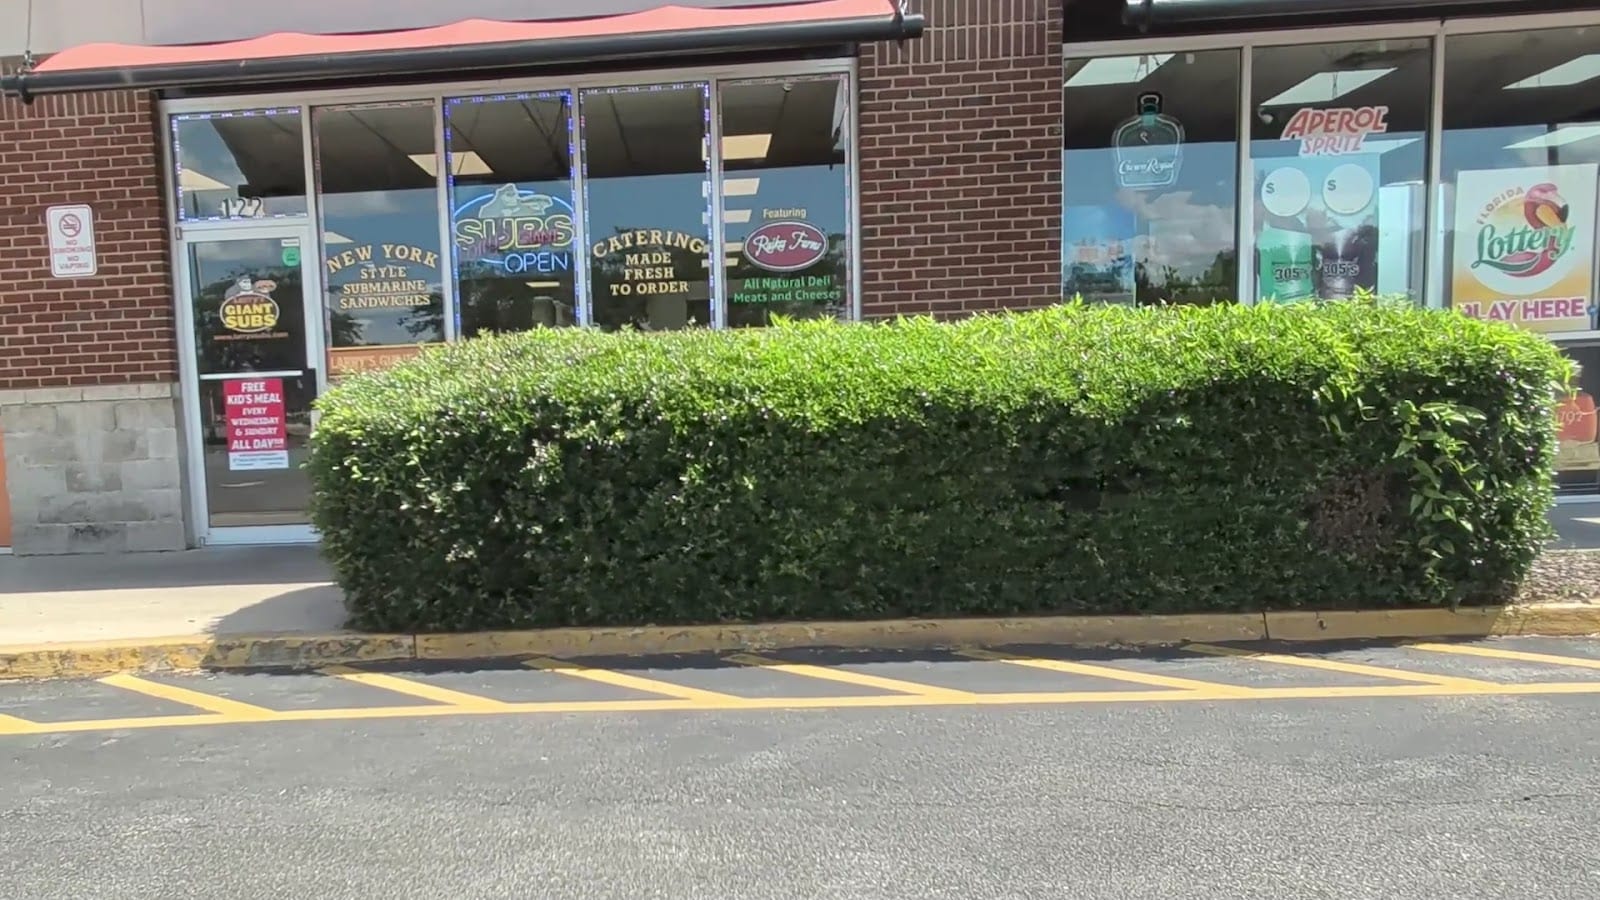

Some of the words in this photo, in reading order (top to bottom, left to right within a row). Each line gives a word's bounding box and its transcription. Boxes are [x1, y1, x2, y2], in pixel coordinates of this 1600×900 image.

[1284, 107, 1387, 138] APEROL
[1303, 135, 1363, 155] SPRITZ
[1476, 187, 1525, 225] FLORIDA
[763, 208, 807, 219] Featuring
[456, 214, 575, 250] SUBS
[593, 229, 705, 257] CATERING
[1471, 223, 1576, 269] Lottery
[327, 245, 373, 274] NEW
[382, 244, 439, 268] YORK
[504, 252, 568, 273] OPEN
[625, 252, 671, 266] MADE
[360, 266, 407, 279] STYLE
[624, 267, 674, 280] FRESH
[343, 280, 426, 295] SUBMARINE
[610, 284, 631, 296] TO
[636, 281, 689, 294] ORDER
[744, 278, 759, 290] All
[762, 276, 805, 289] Natural
[808, 275, 830, 286] Deli
[340, 295, 431, 309] SANDWICHES
[734, 292, 767, 303] Meats
[771, 291, 792, 301] and
[795, 289, 840, 300] Cheeses
[225, 303, 273, 316] GIANT
[1522, 298, 1585, 320] HERE
[224, 314, 276, 329] SUBS
[241, 382, 266, 393] FREE
[227, 394, 252, 405] KID'S
[254, 393, 281, 403] MEAL
[242, 407, 267, 416] EVERY
[230, 417, 279, 426] WEDNESDAY
[235, 428, 243, 436] &
[245, 427, 278, 436] SUNDAY
[232, 440, 252, 450] ALL
